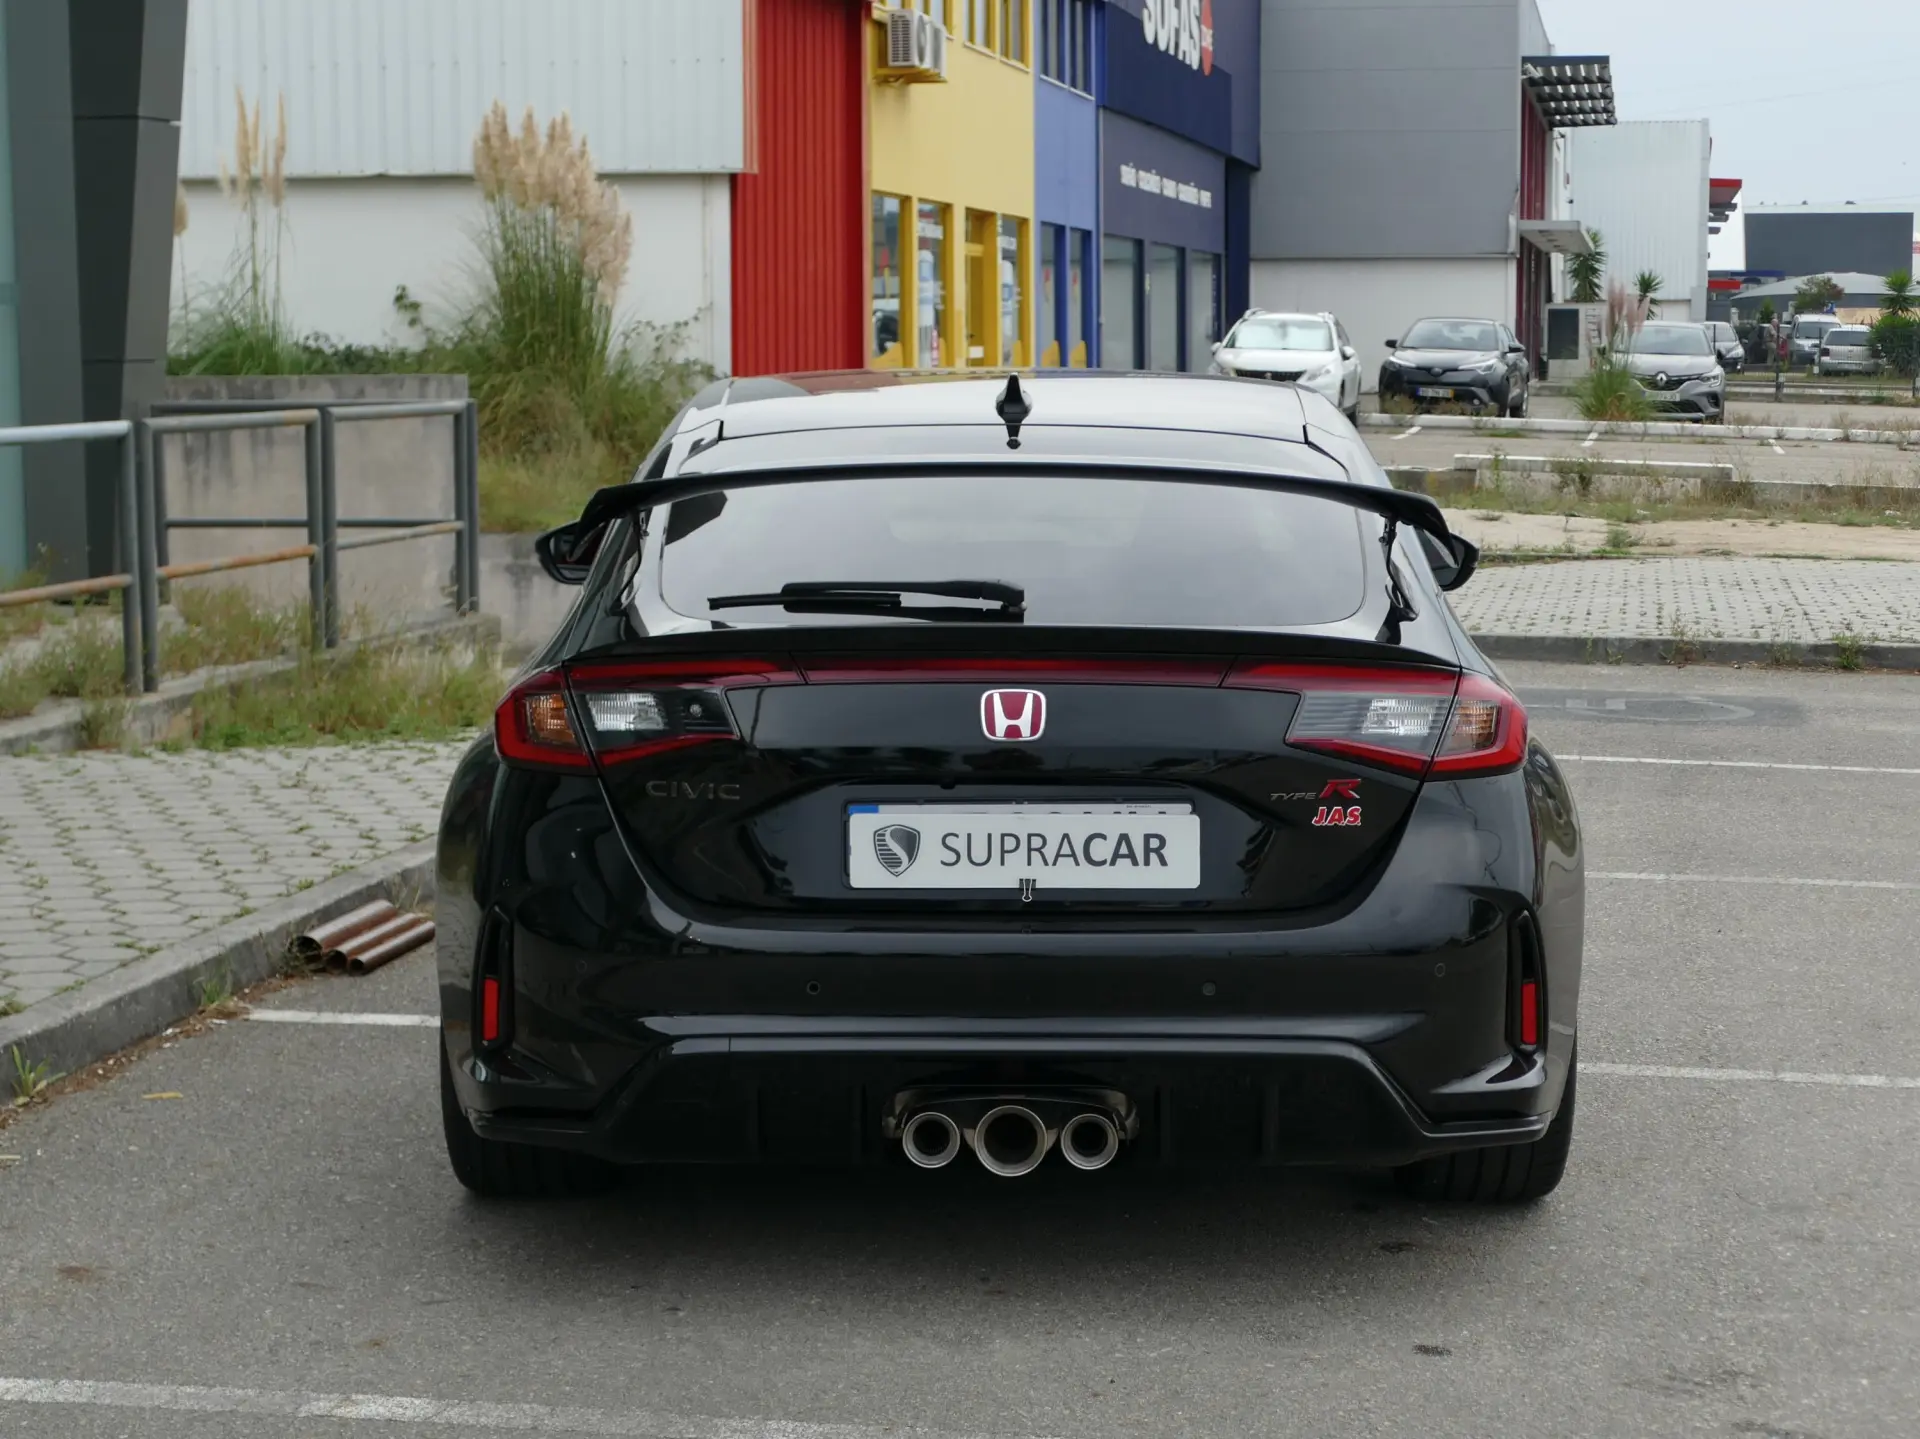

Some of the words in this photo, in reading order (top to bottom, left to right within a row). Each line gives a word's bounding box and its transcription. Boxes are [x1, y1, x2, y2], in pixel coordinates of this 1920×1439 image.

[645, 780, 740, 800] CIVIC
[1270, 792, 1317, 801] TYPE
[1319, 778, 1362, 799] R
[939, 831, 1169, 868] SUPRACAR
